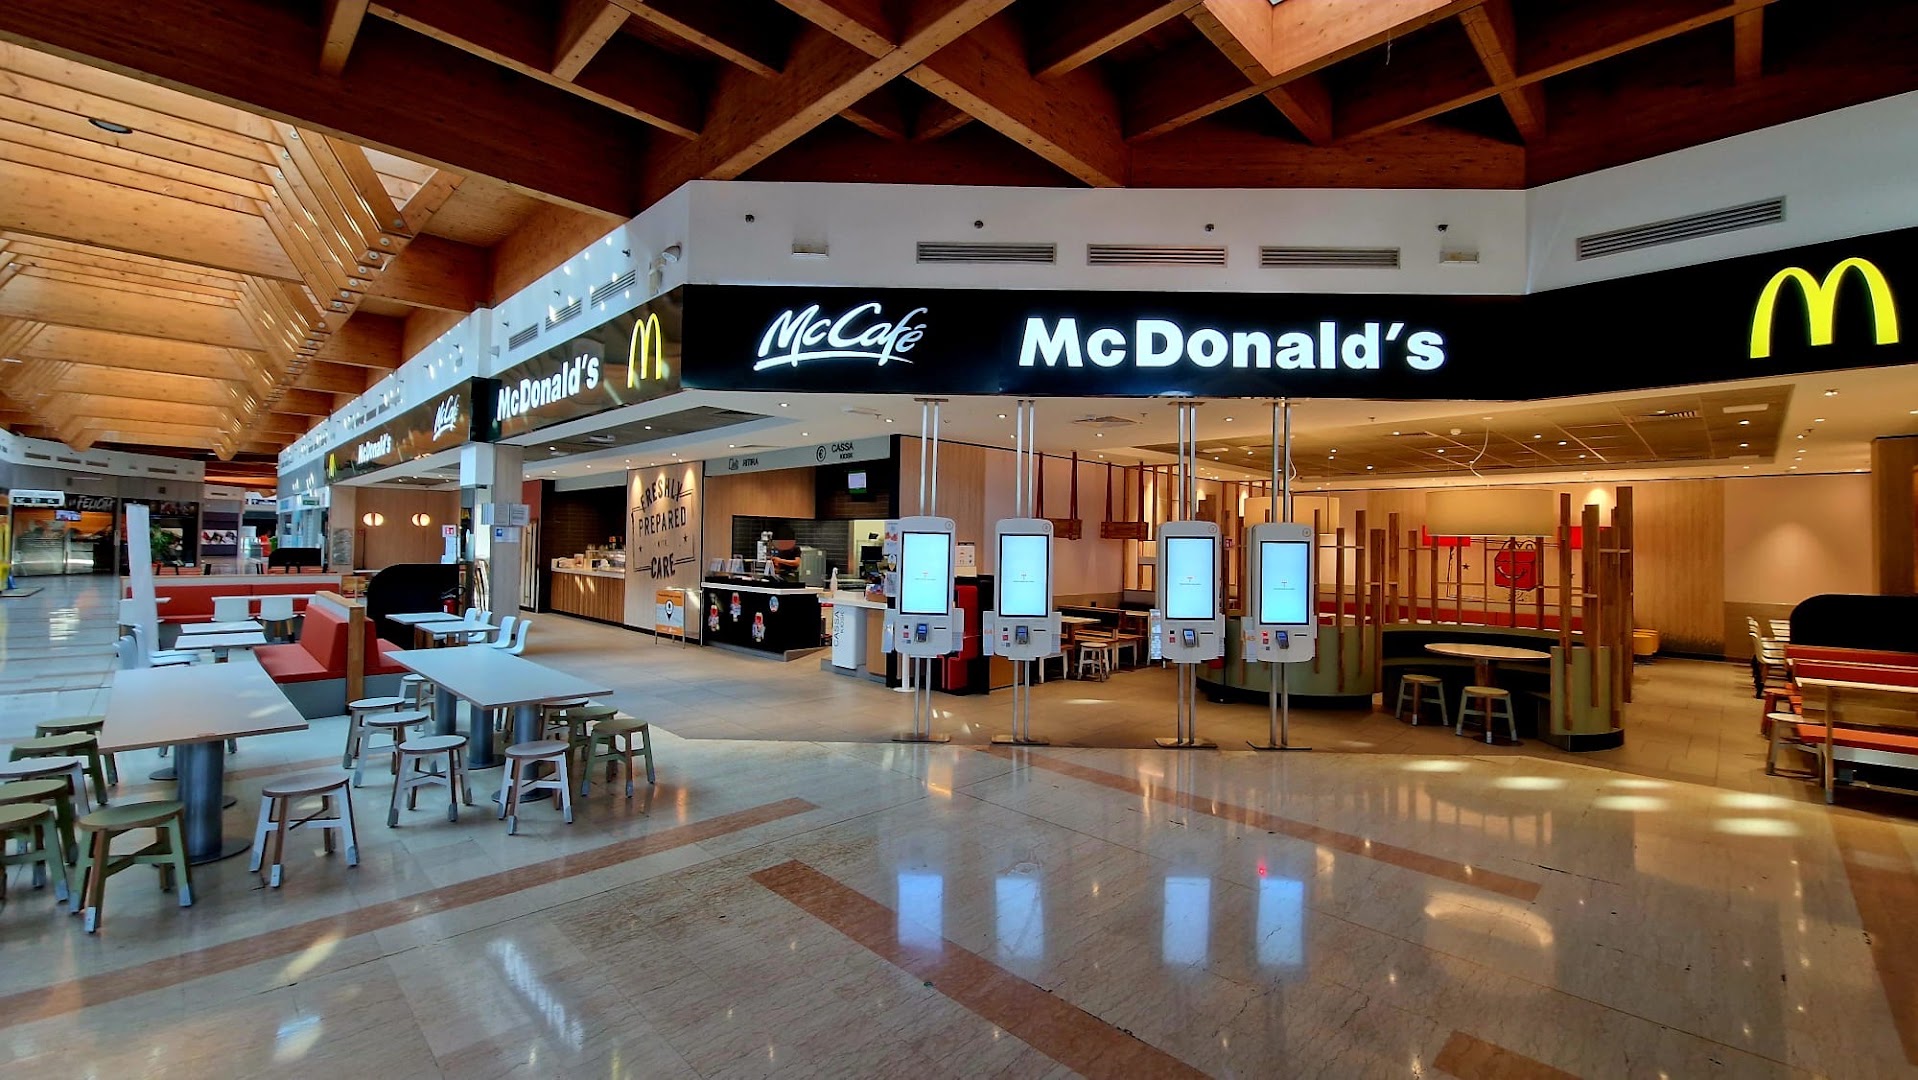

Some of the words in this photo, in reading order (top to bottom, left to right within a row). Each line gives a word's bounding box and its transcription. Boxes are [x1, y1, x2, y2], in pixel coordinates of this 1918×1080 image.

[753, 302, 929, 370] McCafé
[1018, 317, 1446, 371] McDonald's
[496, 353, 600, 421] McDonald's
[357, 433, 392, 465] McDonald's
[831, 442, 854, 453] CASSA
[640, 478, 683, 513] FRESHLY
[639, 506, 686, 538] PREPARED
[650, 552, 676, 580] CARE
